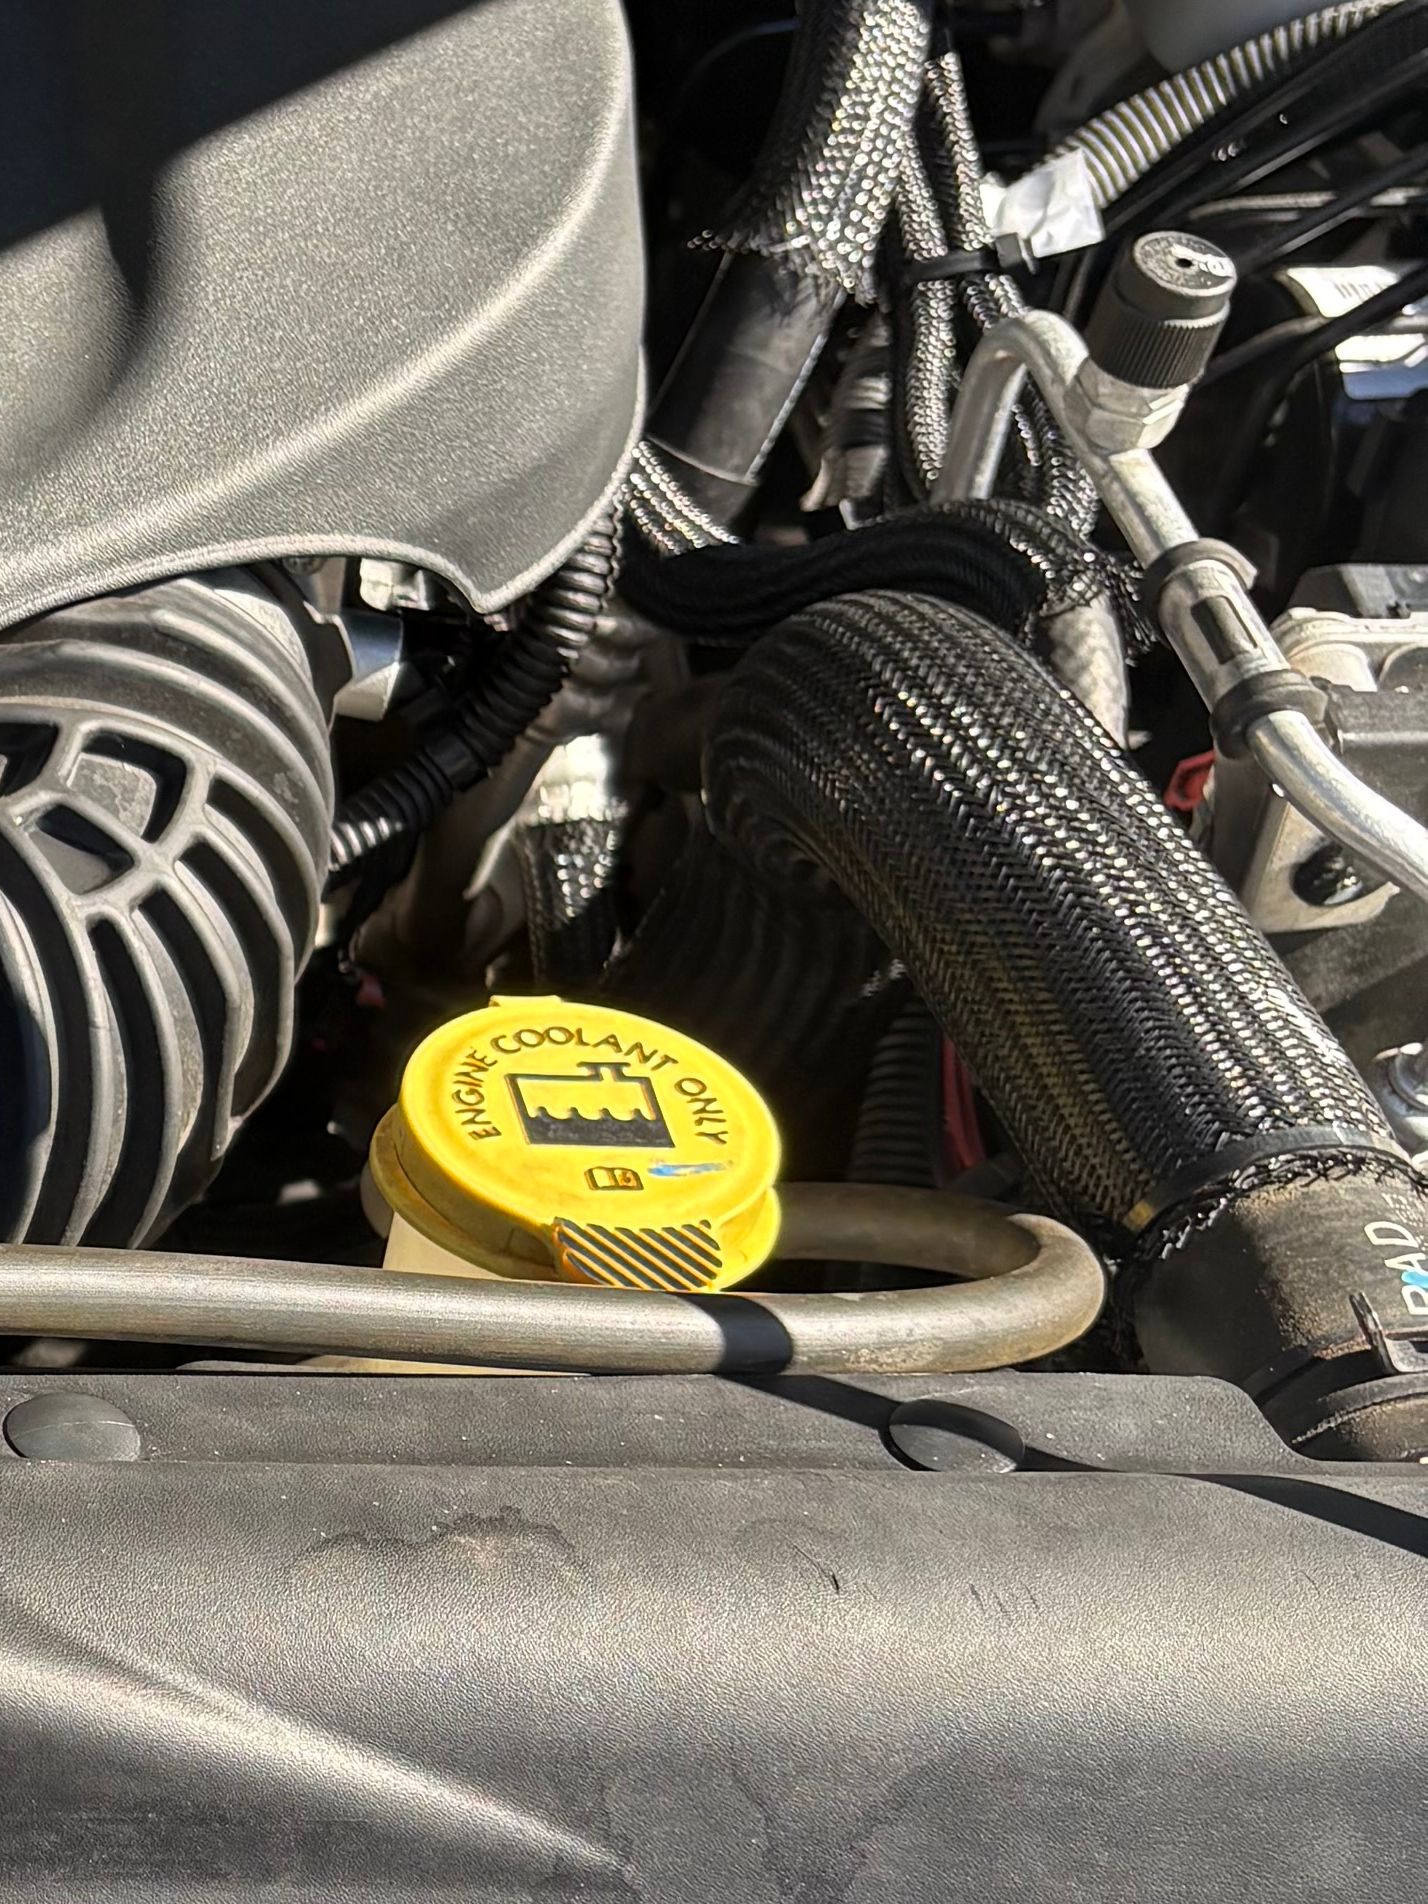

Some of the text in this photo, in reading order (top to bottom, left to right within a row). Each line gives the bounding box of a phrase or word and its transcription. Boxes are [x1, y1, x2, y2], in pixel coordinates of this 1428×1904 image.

[449, 1025, 730, 1146] ENGINE COOLANT ONLY
